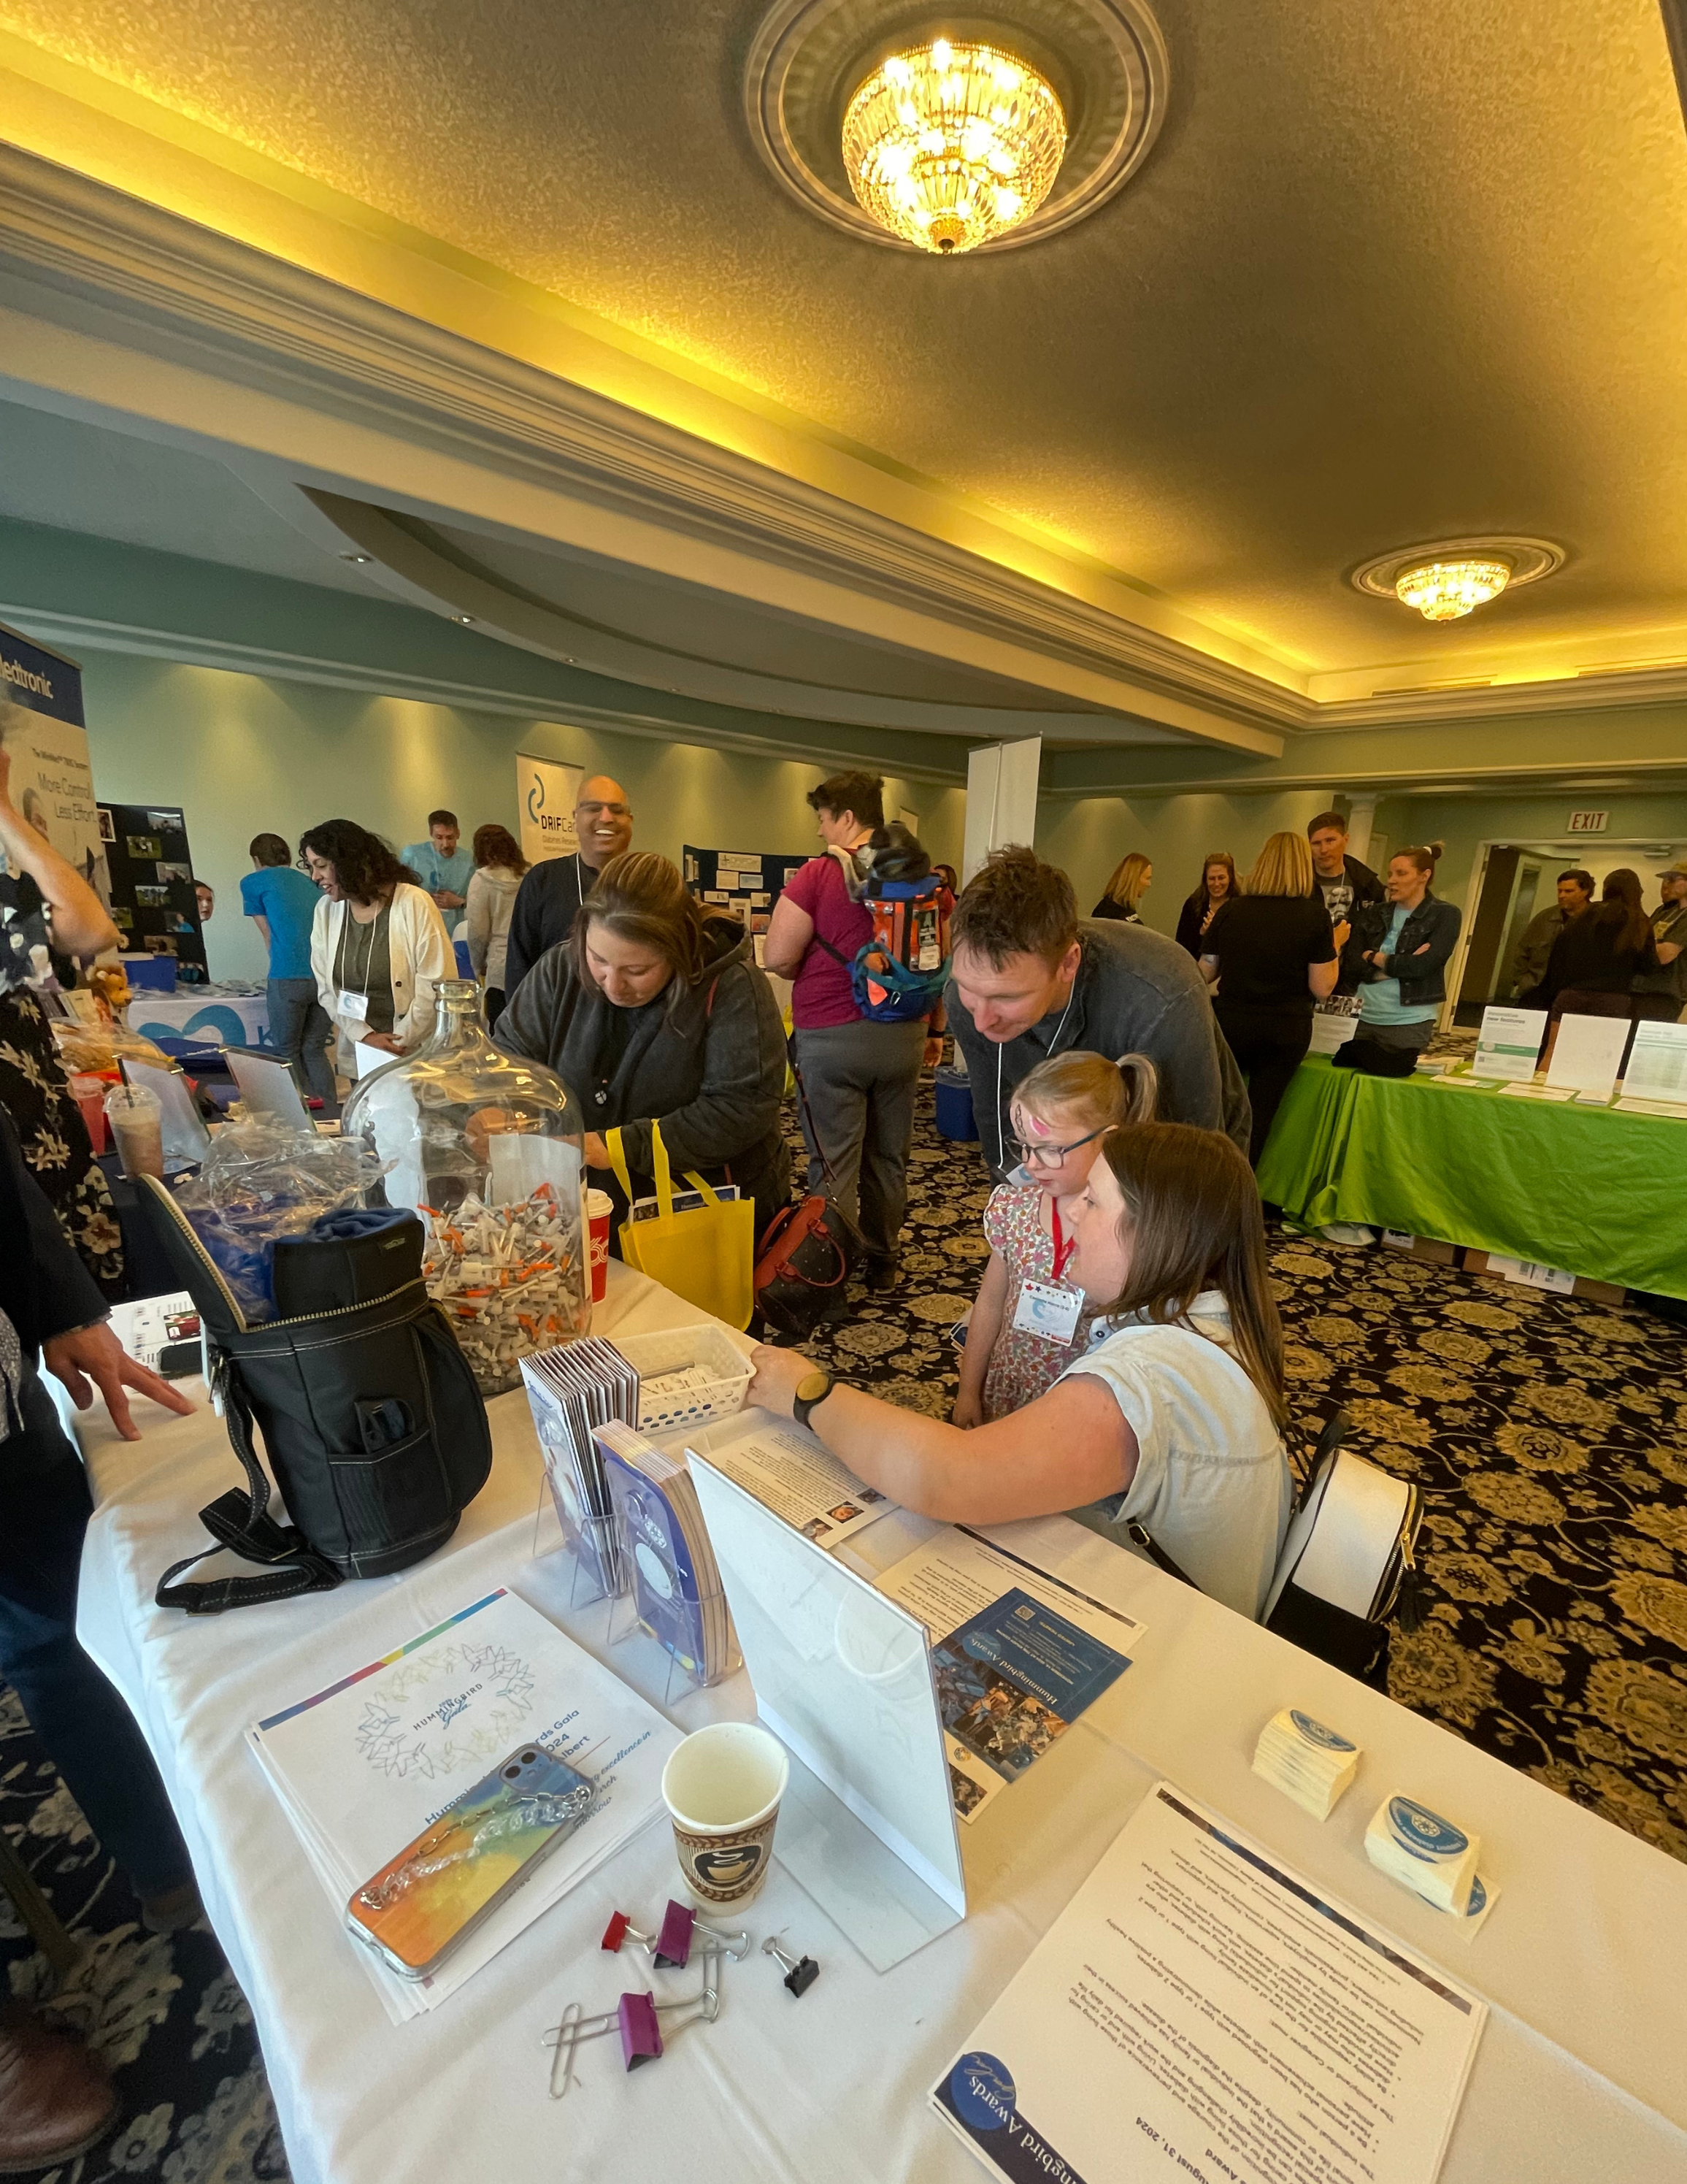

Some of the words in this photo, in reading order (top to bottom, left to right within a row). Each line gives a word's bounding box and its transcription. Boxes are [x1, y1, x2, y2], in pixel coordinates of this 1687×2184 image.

[1572, 813, 1605, 829] EXIT
[967, 1637, 1002, 1663] Awards
[997, 1658, 1060, 1705] Hummingbird
[413, 1683, 483, 1731] HUMMINGBIRD
[534, 1729, 553, 1746] rds
[553, 1709, 580, 1730] Gala
[545, 1733, 570, 1752] 024
[600, 1737, 643, 1775] excellence
[641, 1730, 651, 1742] in
[1069, 1996, 1081, 2009] with
[1080, 1994, 1099, 2012] caring
[1082, 2008, 1099, 2027] living
[1100, 2026, 1117, 2042] those
[1122, 2032, 1134, 2045] with
[1137, 2045, 1156, 2065] Living
[1127, 2049, 1172, 2090] perseverance
[969, 2076, 1022, 2134] Awards
[1190, 2093, 1204, 2107] with
[1136, 2117, 1159, 2141] 2024
[1187, 2104, 1215, 2131] courage
[1207, 2107, 1226, 2129] living
[1228, 2127, 1248, 2147] those
[1021, 2133, 1077, 2184] ngbird
[1204, 2148, 1237, 2180] Award
[1263, 2157, 1286, 2180] caring
